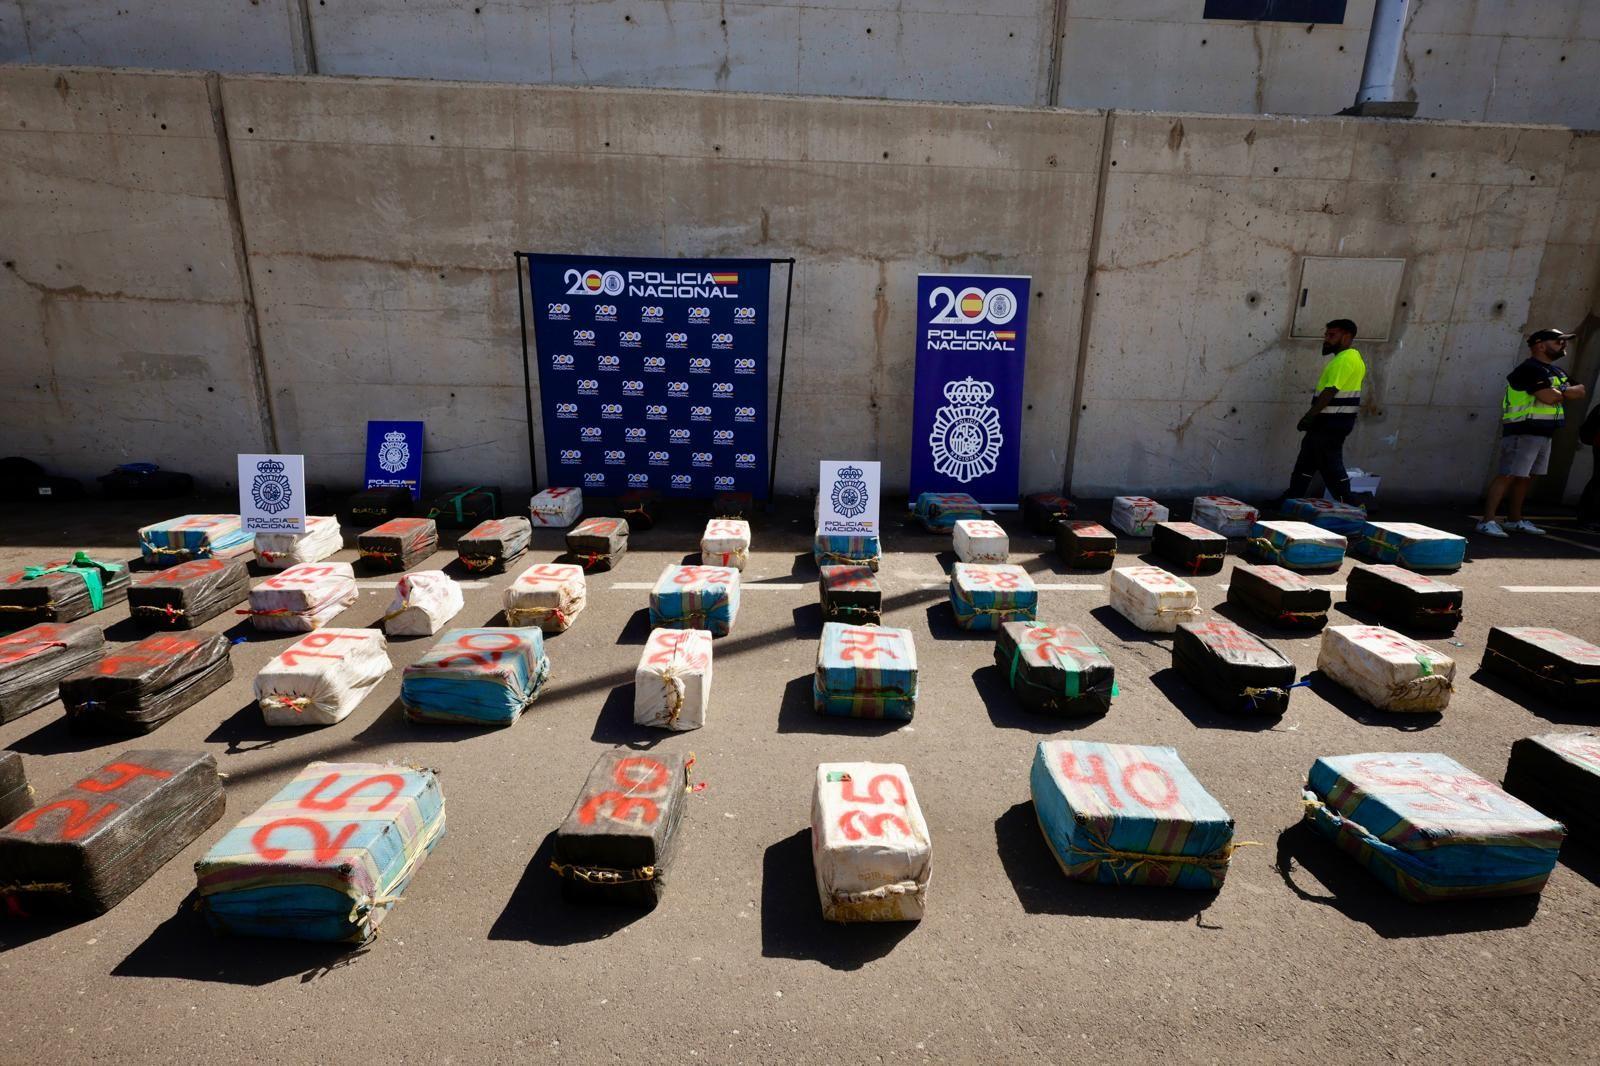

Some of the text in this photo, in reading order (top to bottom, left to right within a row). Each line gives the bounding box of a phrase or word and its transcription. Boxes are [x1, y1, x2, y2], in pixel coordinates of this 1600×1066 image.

[564, 269, 625, 296] 200
[628, 271, 716, 285] POLICIA
[629, 286, 738, 298] NACIONAL
[929, 286, 1018, 325] 200
[927, 329, 997, 341] POLICIA
[927, 340, 1016, 351] NACIONAL
[954, 416, 980, 428] POLICIA
[950, 450, 983, 463] NACIONAL
[265, 566, 334, 589] 13
[521, 565, 581, 584] 15
[963, 569, 1020, 590] 38
[280, 633, 369, 667] 19
[438, 633, 522, 670] 20
[839, 629, 900, 661] 34
[578, 756, 669, 827] 30
[1060, 751, 1180, 810] 40
[14, 761, 173, 840] 24
[838, 773, 911, 841] 35
[250, 772, 405, 862] 25
